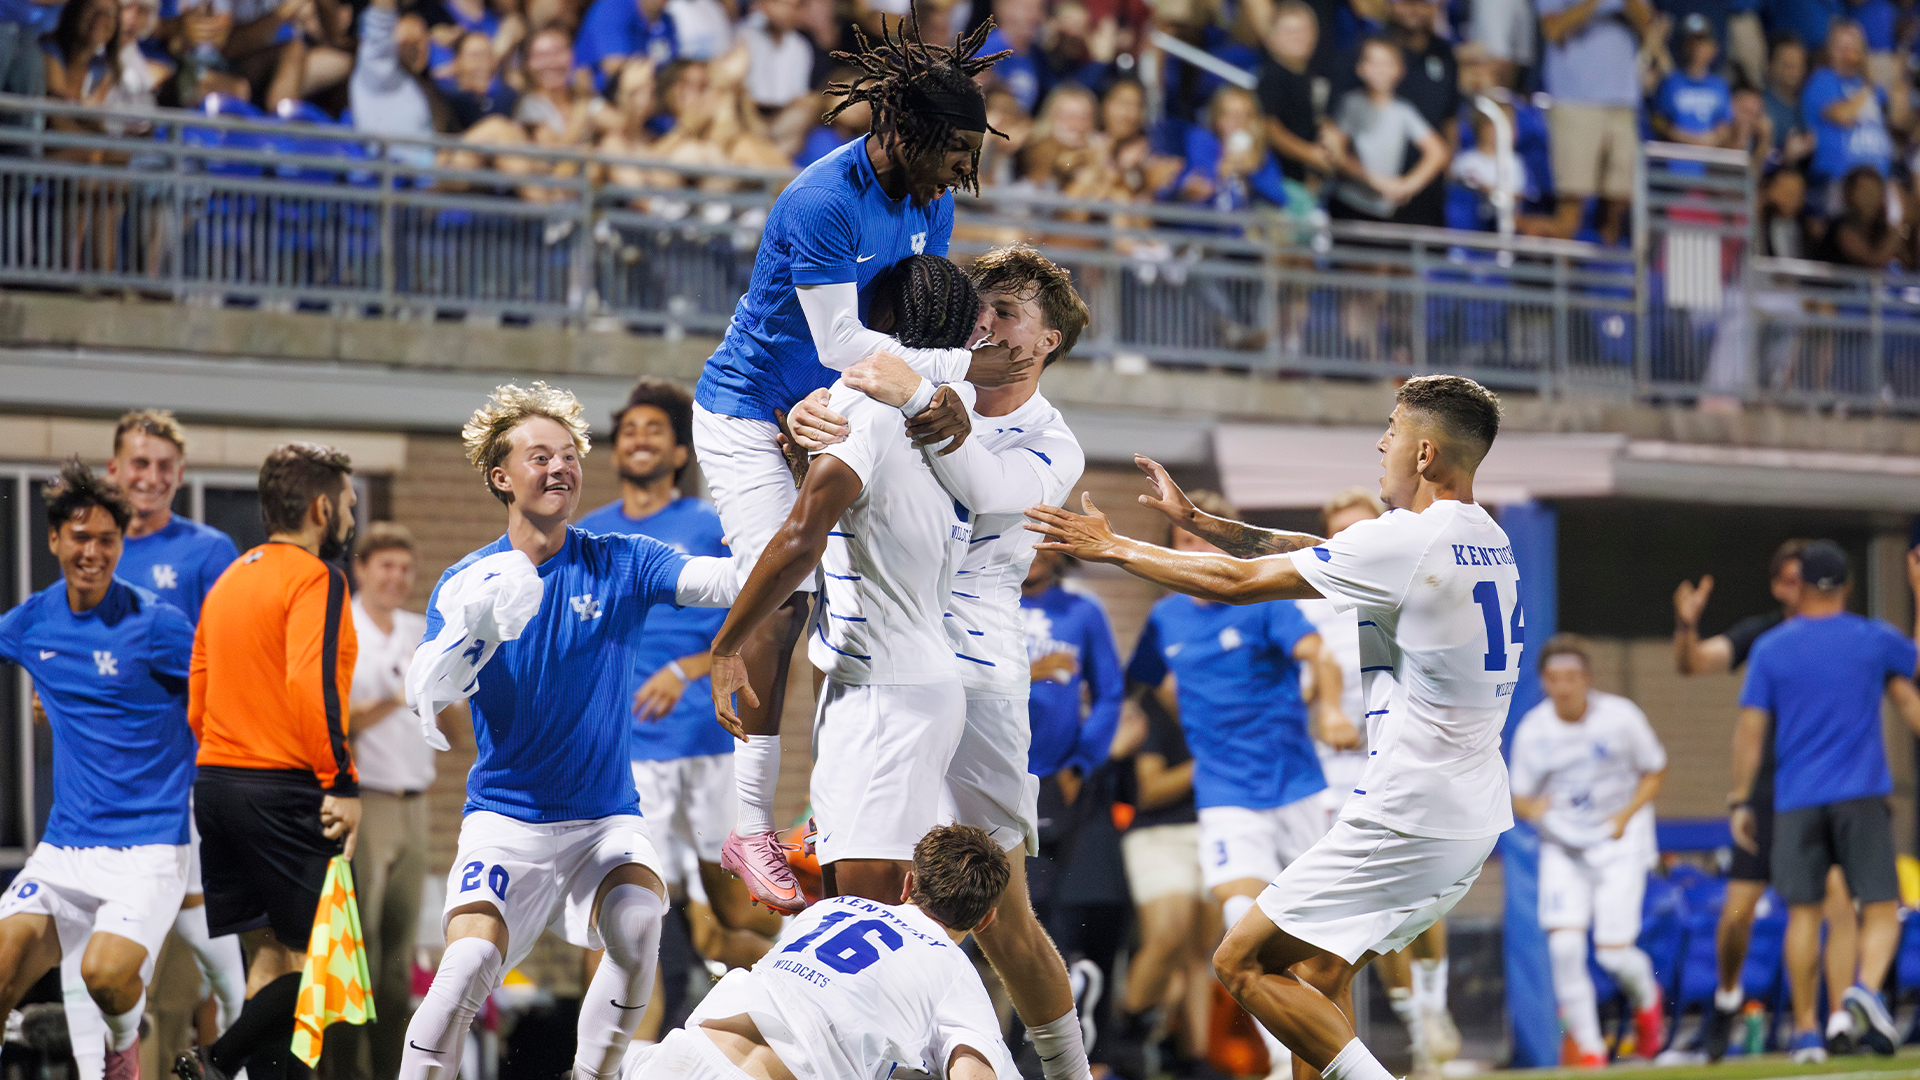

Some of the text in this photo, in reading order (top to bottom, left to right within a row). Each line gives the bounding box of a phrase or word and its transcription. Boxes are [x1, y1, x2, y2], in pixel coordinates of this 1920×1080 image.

[459, 860, 510, 902] 20
[780, 911, 904, 975] 16
[773, 959, 831, 988] WILDCATS
